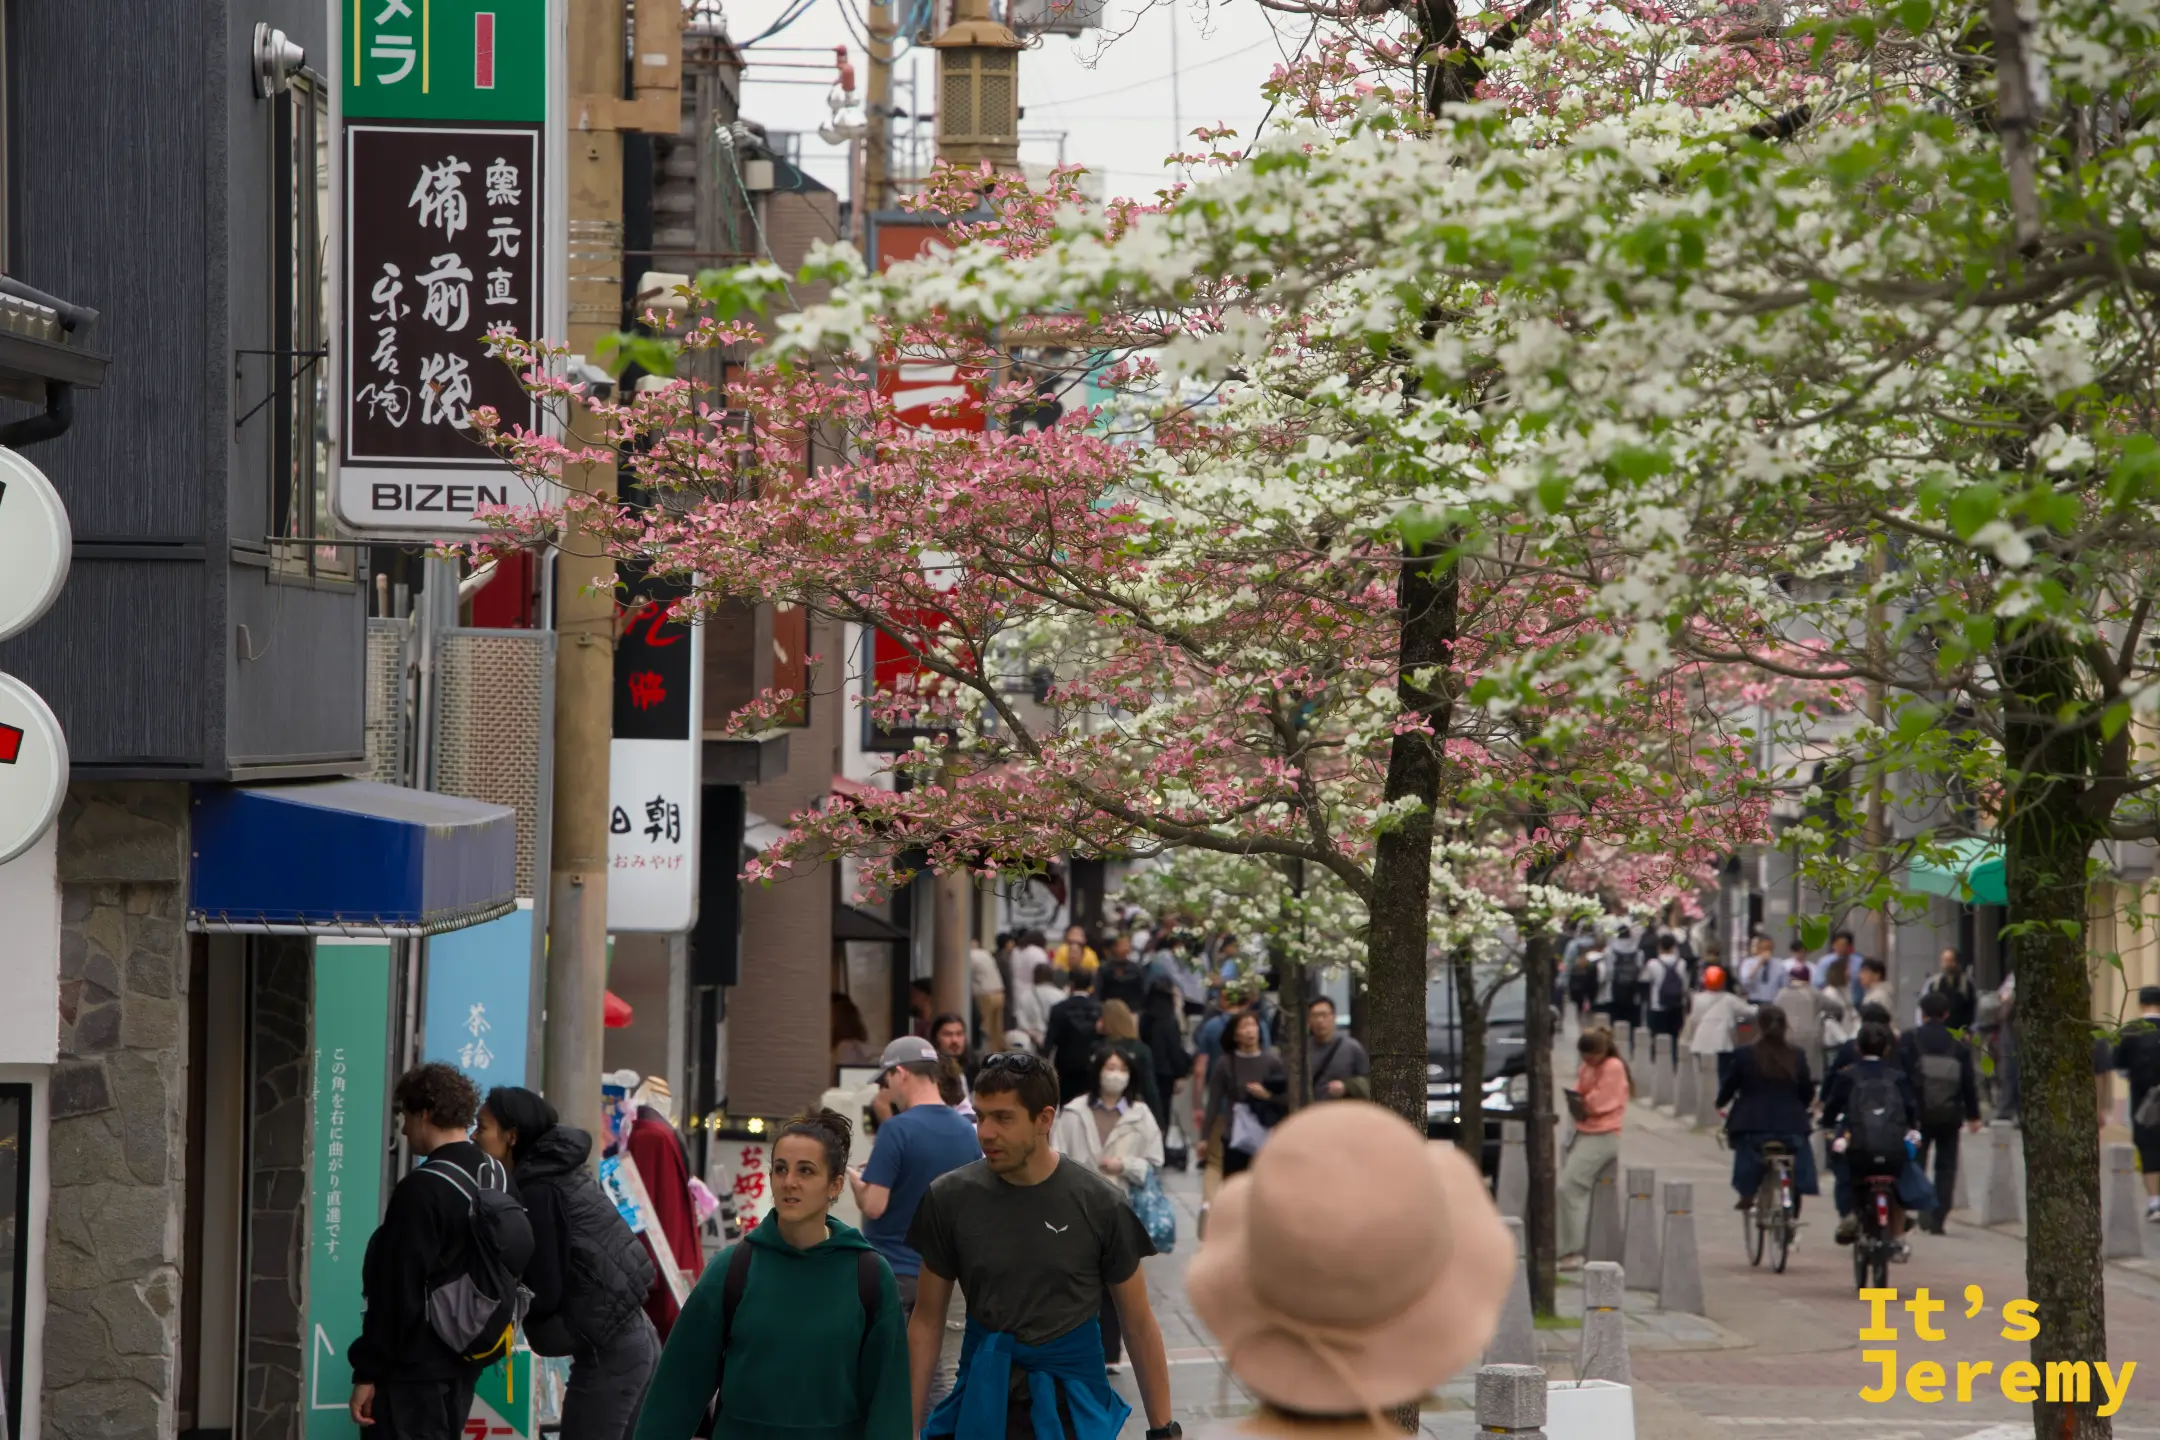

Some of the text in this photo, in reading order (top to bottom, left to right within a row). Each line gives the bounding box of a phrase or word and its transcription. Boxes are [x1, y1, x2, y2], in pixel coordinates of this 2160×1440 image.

[372, 483, 507, 512] BIZEN
[325, 1047, 347, 1263] この角を右に曲がり直進です。
